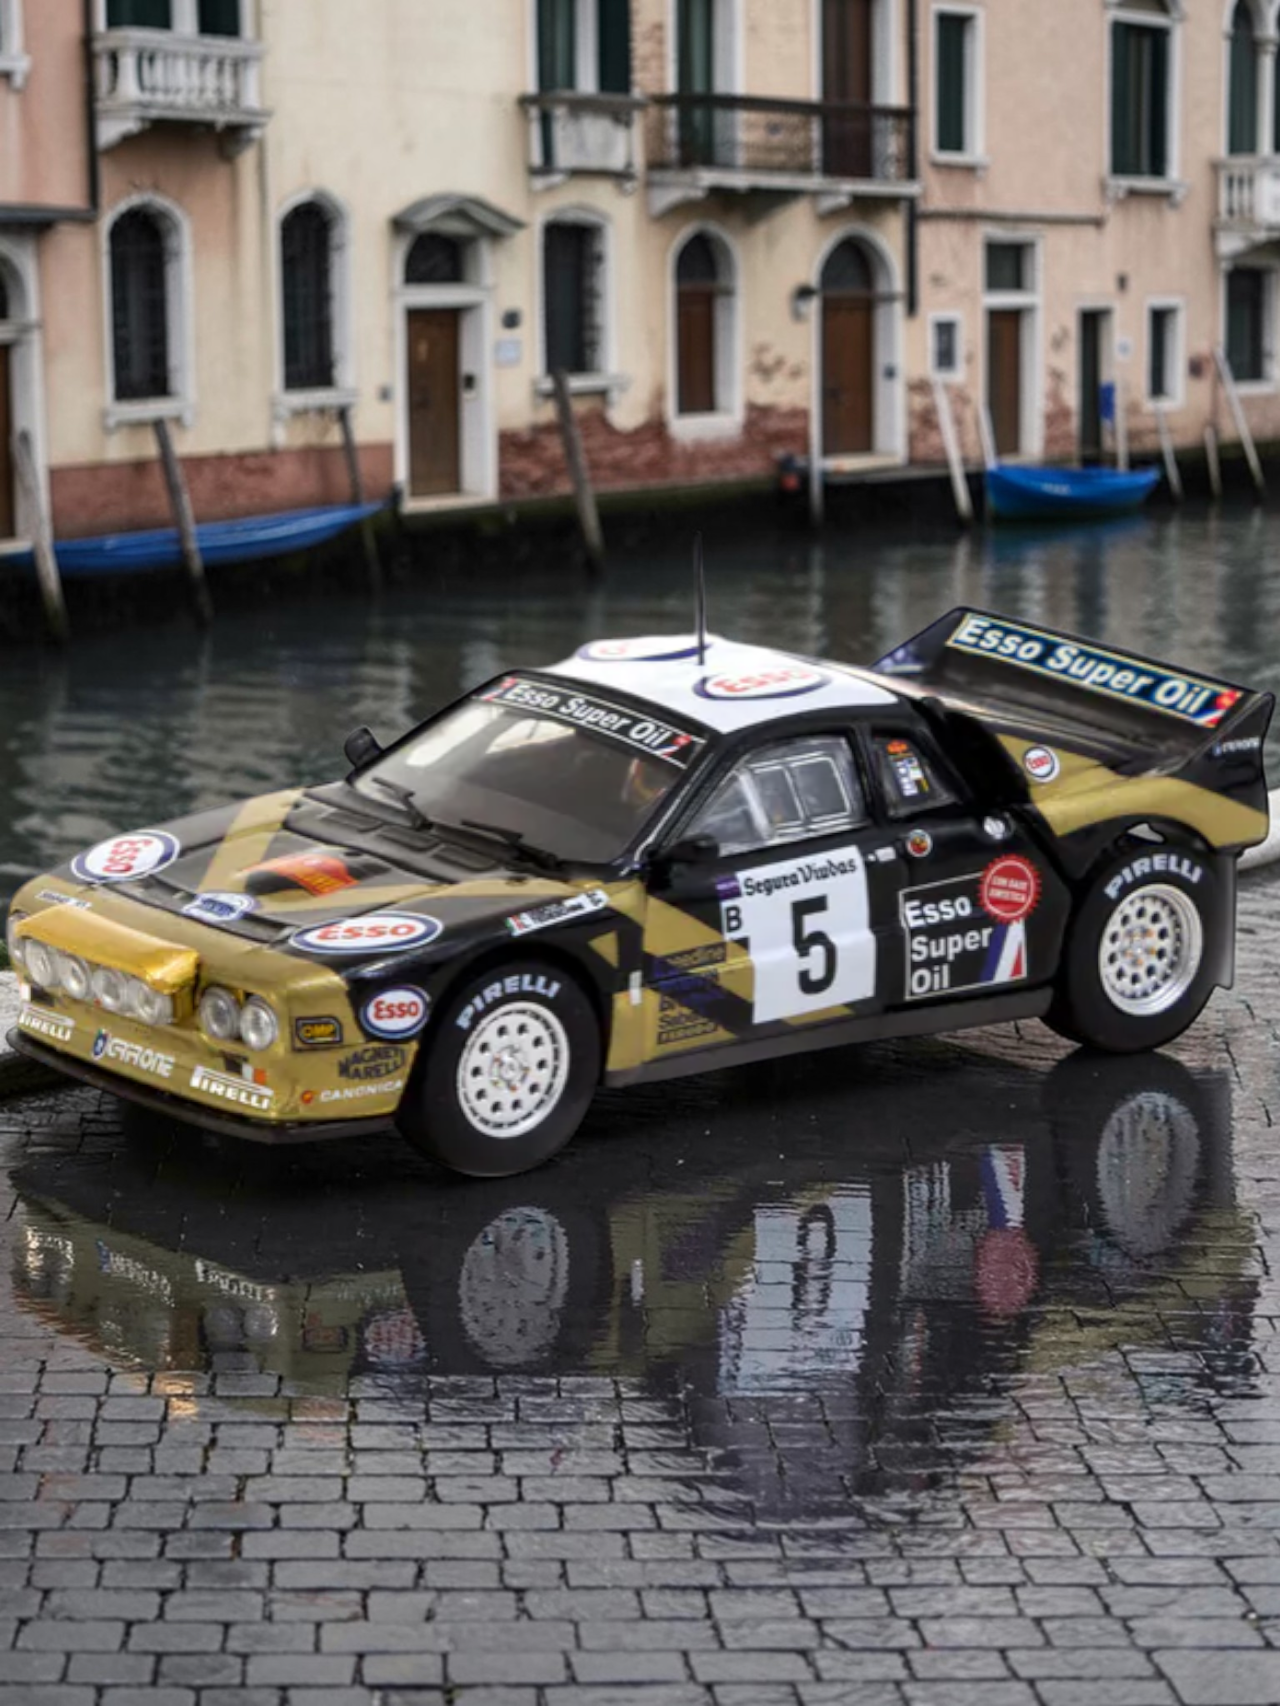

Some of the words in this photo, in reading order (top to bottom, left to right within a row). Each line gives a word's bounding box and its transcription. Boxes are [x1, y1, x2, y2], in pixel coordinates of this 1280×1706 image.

[955, 617, 1042, 661] Esso
[1045, 645, 1154, 694] Super
[1153, 678, 1211, 715] Oil
[504, 683, 560, 709] Esso
[559, 696, 632, 731] Super
[629, 721, 672, 747] Oil
[743, 872, 800, 896] Segura
[1104, 853, 1202, 899] PIRELLI
[724, 906, 742, 933] B
[905, 896, 973, 928] Esso
[791, 894, 838, 995] 5
[911, 926, 993, 962] Super
[911, 964, 950, 994] Oil
[373, 999, 420, 1021] Esso
[456, 973, 562, 1030] PIRELLI
[18, 1002, 76, 1042] PIRELLI
[189, 1064, 274, 1111] PIRELLI
